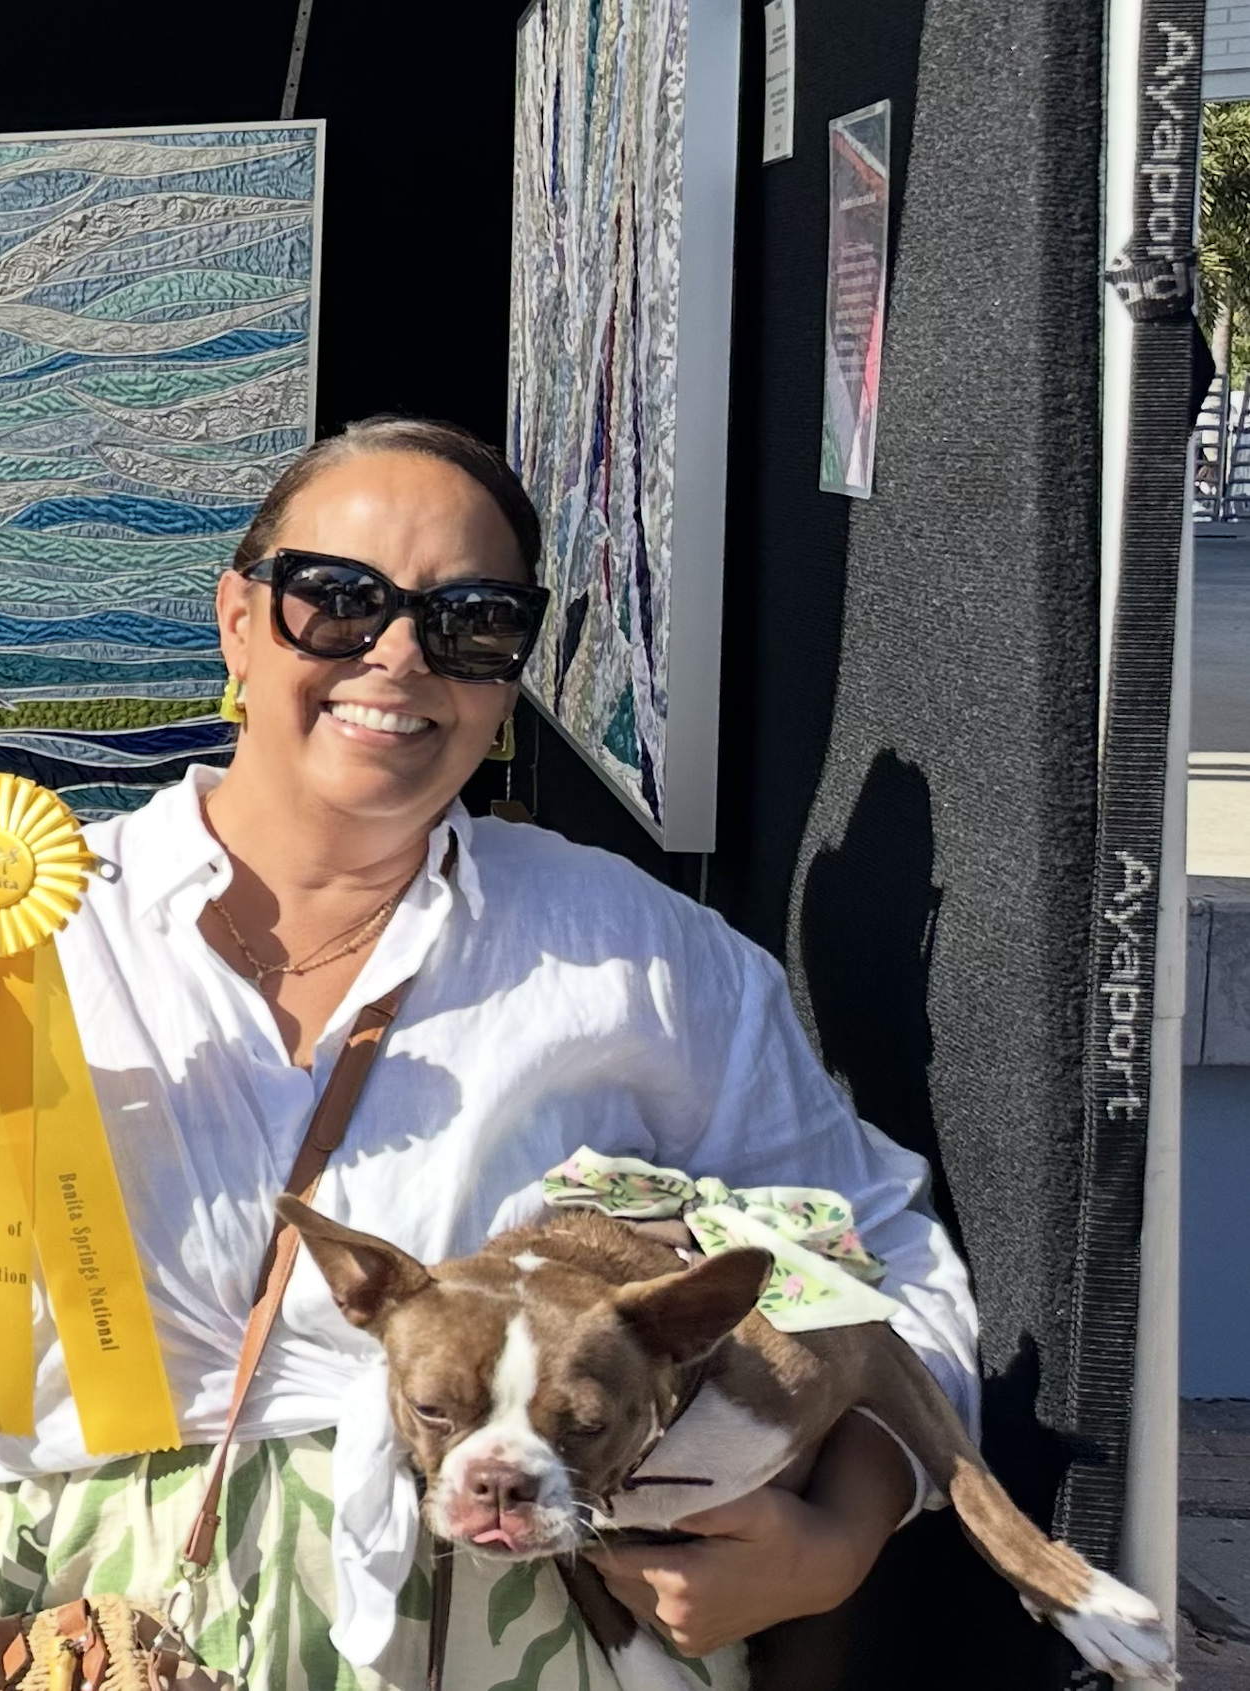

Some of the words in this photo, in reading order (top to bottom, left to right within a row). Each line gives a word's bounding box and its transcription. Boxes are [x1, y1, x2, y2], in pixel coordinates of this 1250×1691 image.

[1140, 21, 1196, 262] Ayapor
[1100, 850, 1152, 1121] Ayaport
[58, 1172, 85, 1222] Bonita
[7, 1220, 23, 1238] of
[69, 1225, 100, 1282] Springs
[88, 1285, 120, 1352] National
